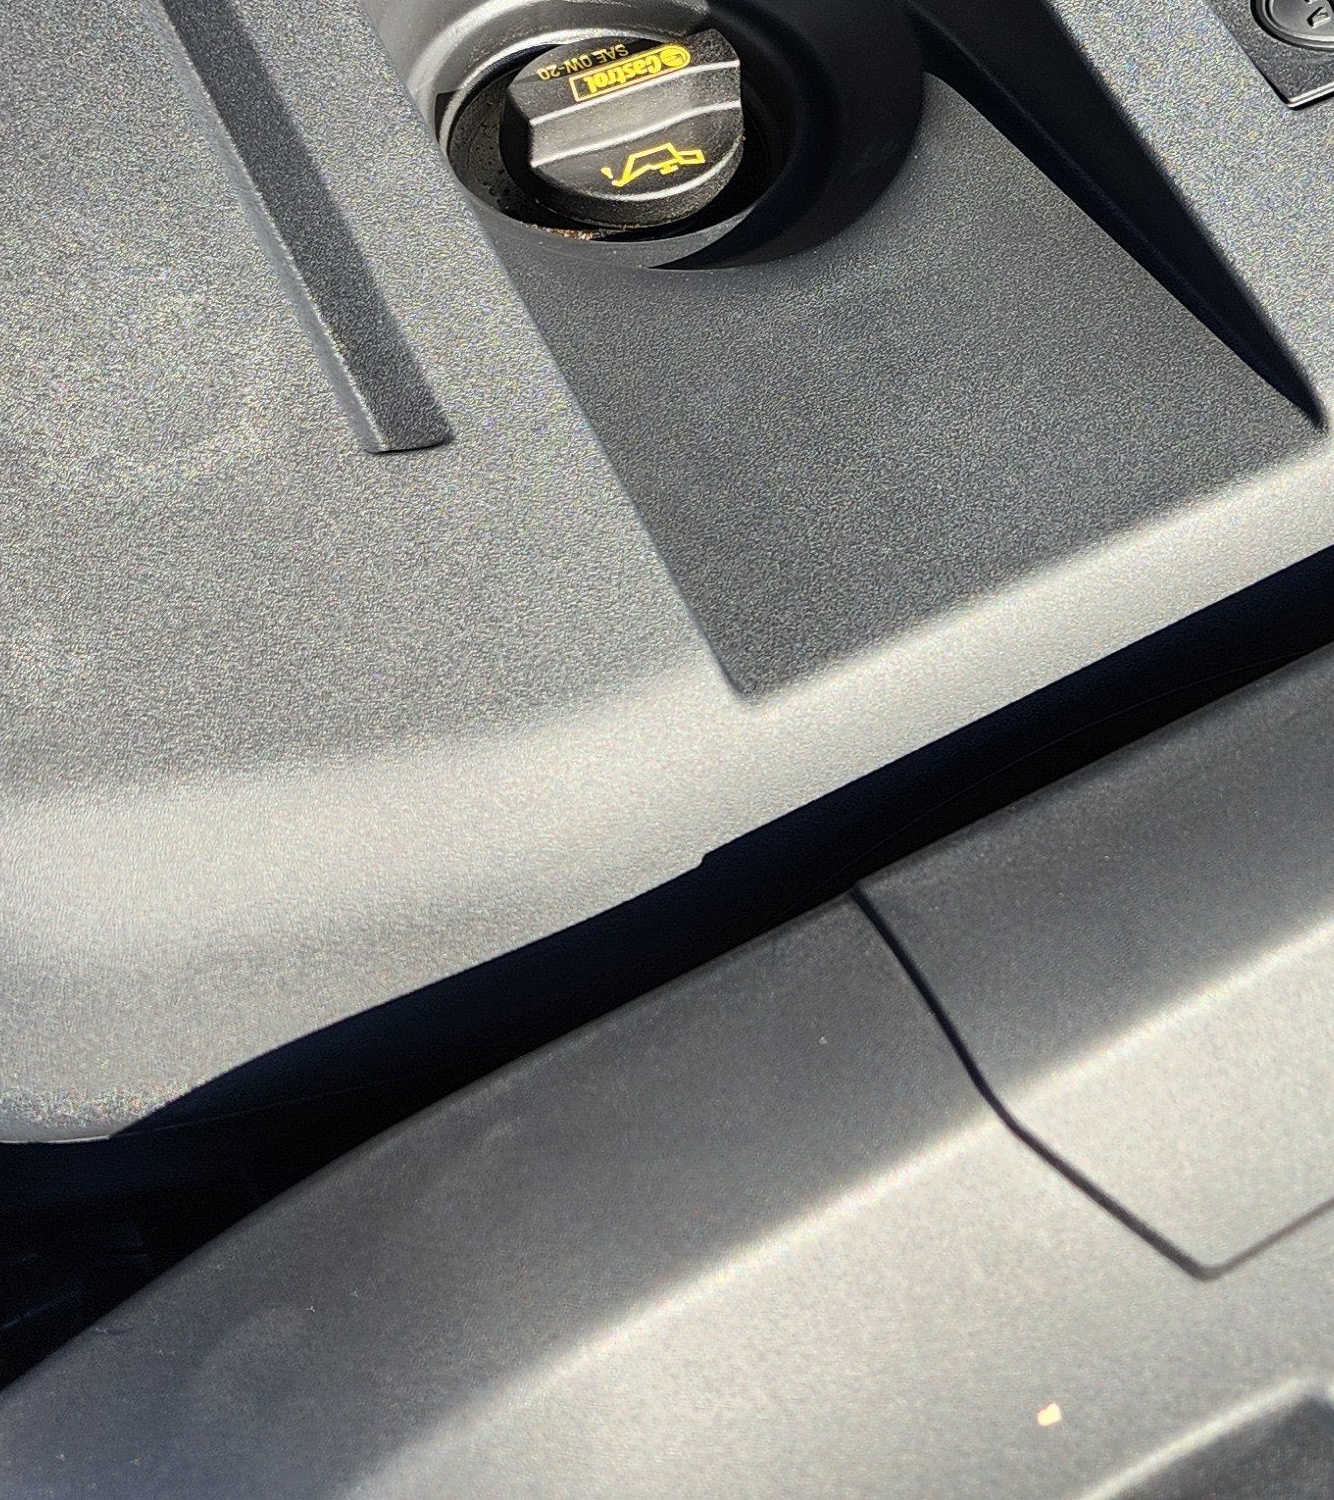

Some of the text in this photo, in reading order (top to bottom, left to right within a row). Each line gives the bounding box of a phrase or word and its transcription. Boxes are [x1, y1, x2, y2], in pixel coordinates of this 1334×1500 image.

[536, 43, 629, 81] SAE 0W-20
[583, 55, 662, 94] Castrol
